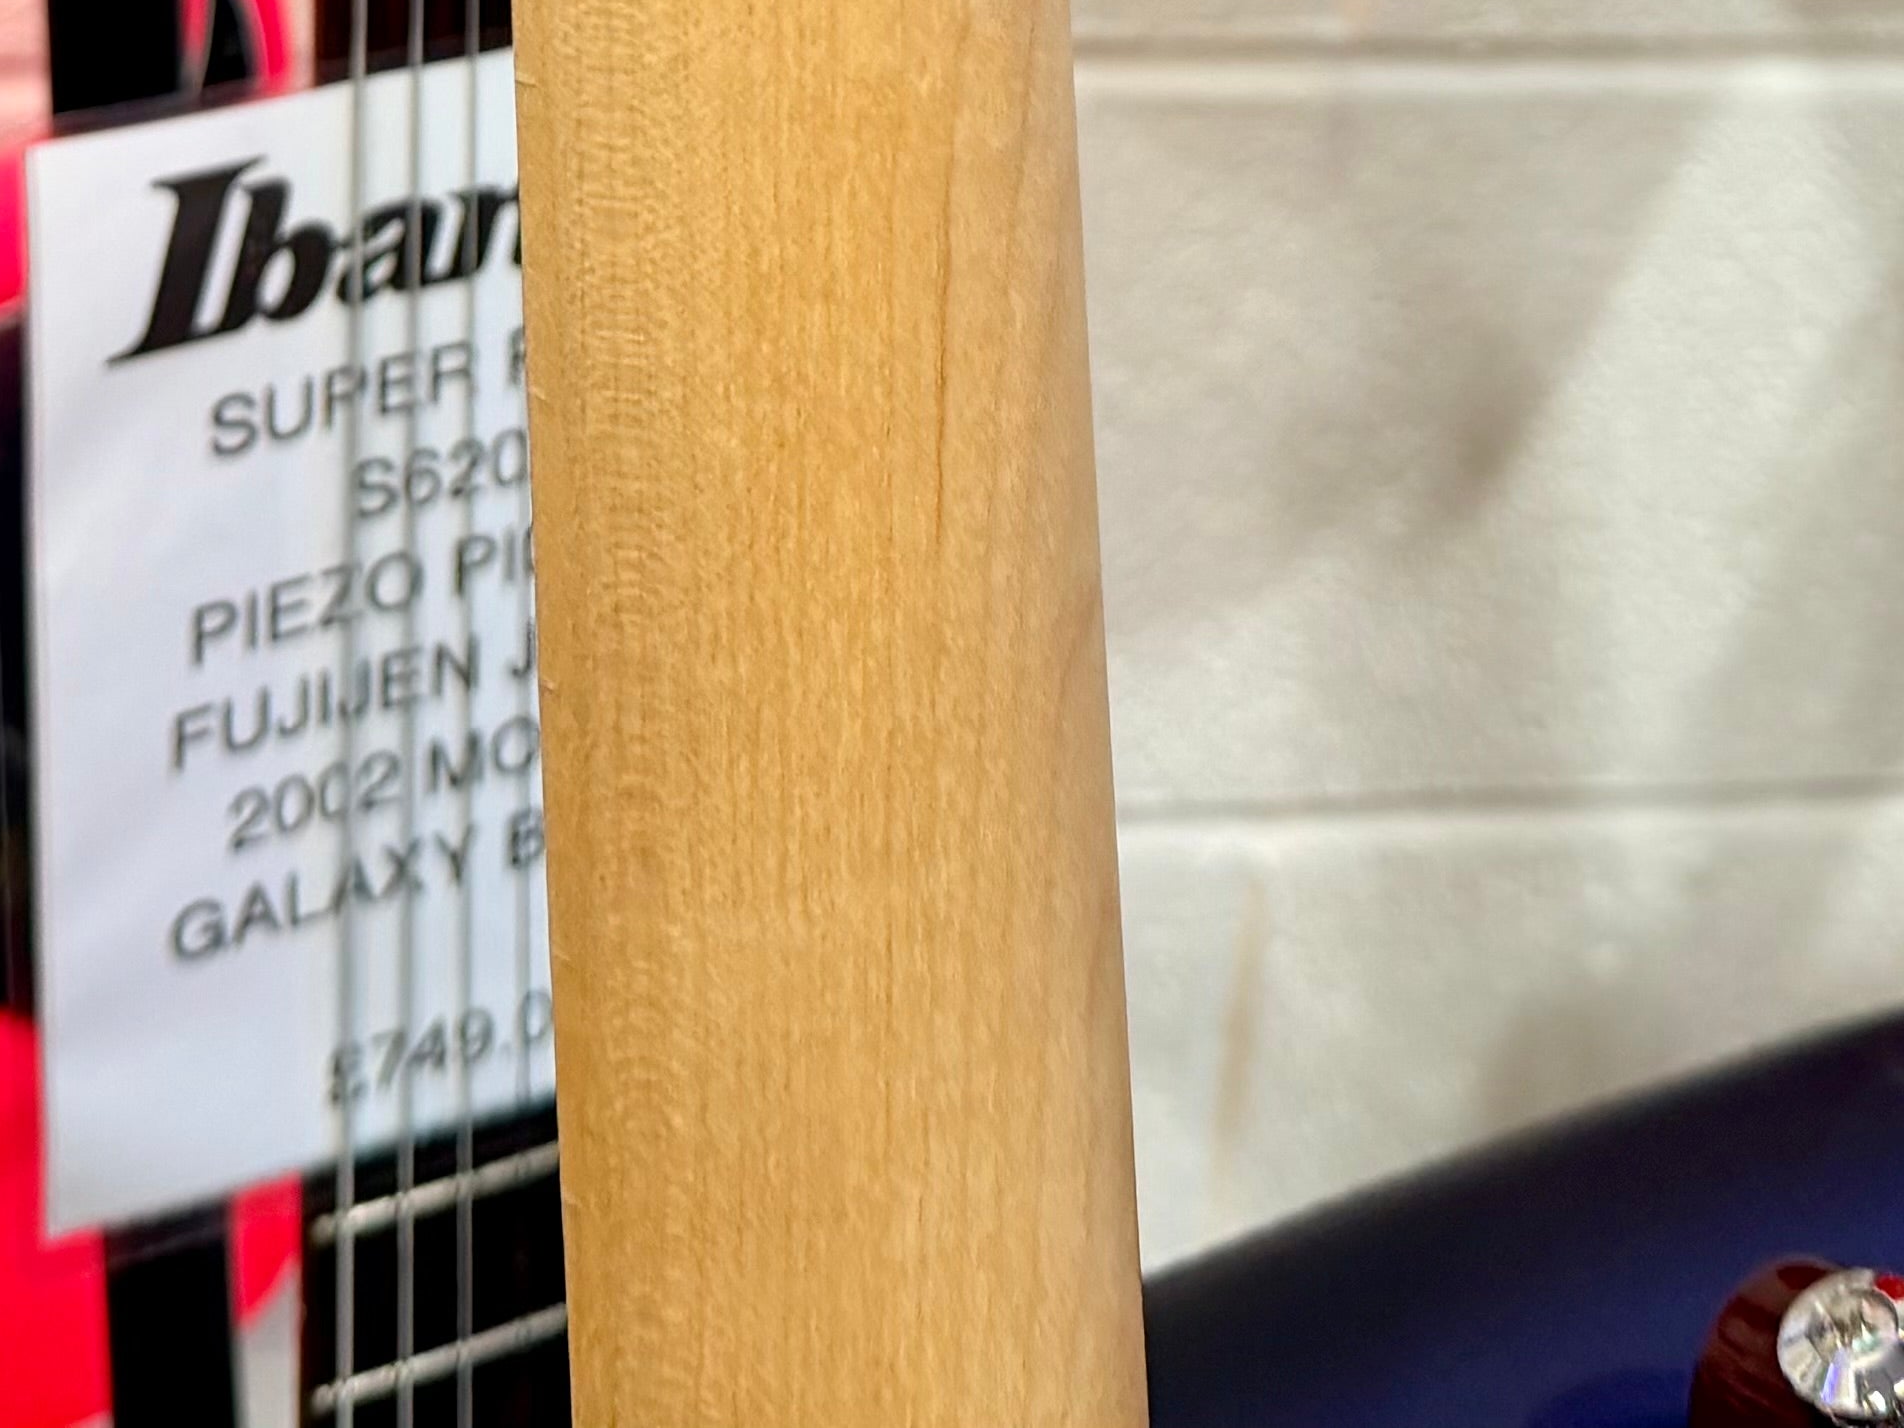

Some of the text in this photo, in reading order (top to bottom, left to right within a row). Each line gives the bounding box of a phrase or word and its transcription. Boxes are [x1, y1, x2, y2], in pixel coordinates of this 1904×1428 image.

[211, 341, 475, 458] SUPER
[190, 550, 424, 666] PIEZO
[226, 748, 402, 853] 2002
[170, 820, 477, 960] GALAXY
